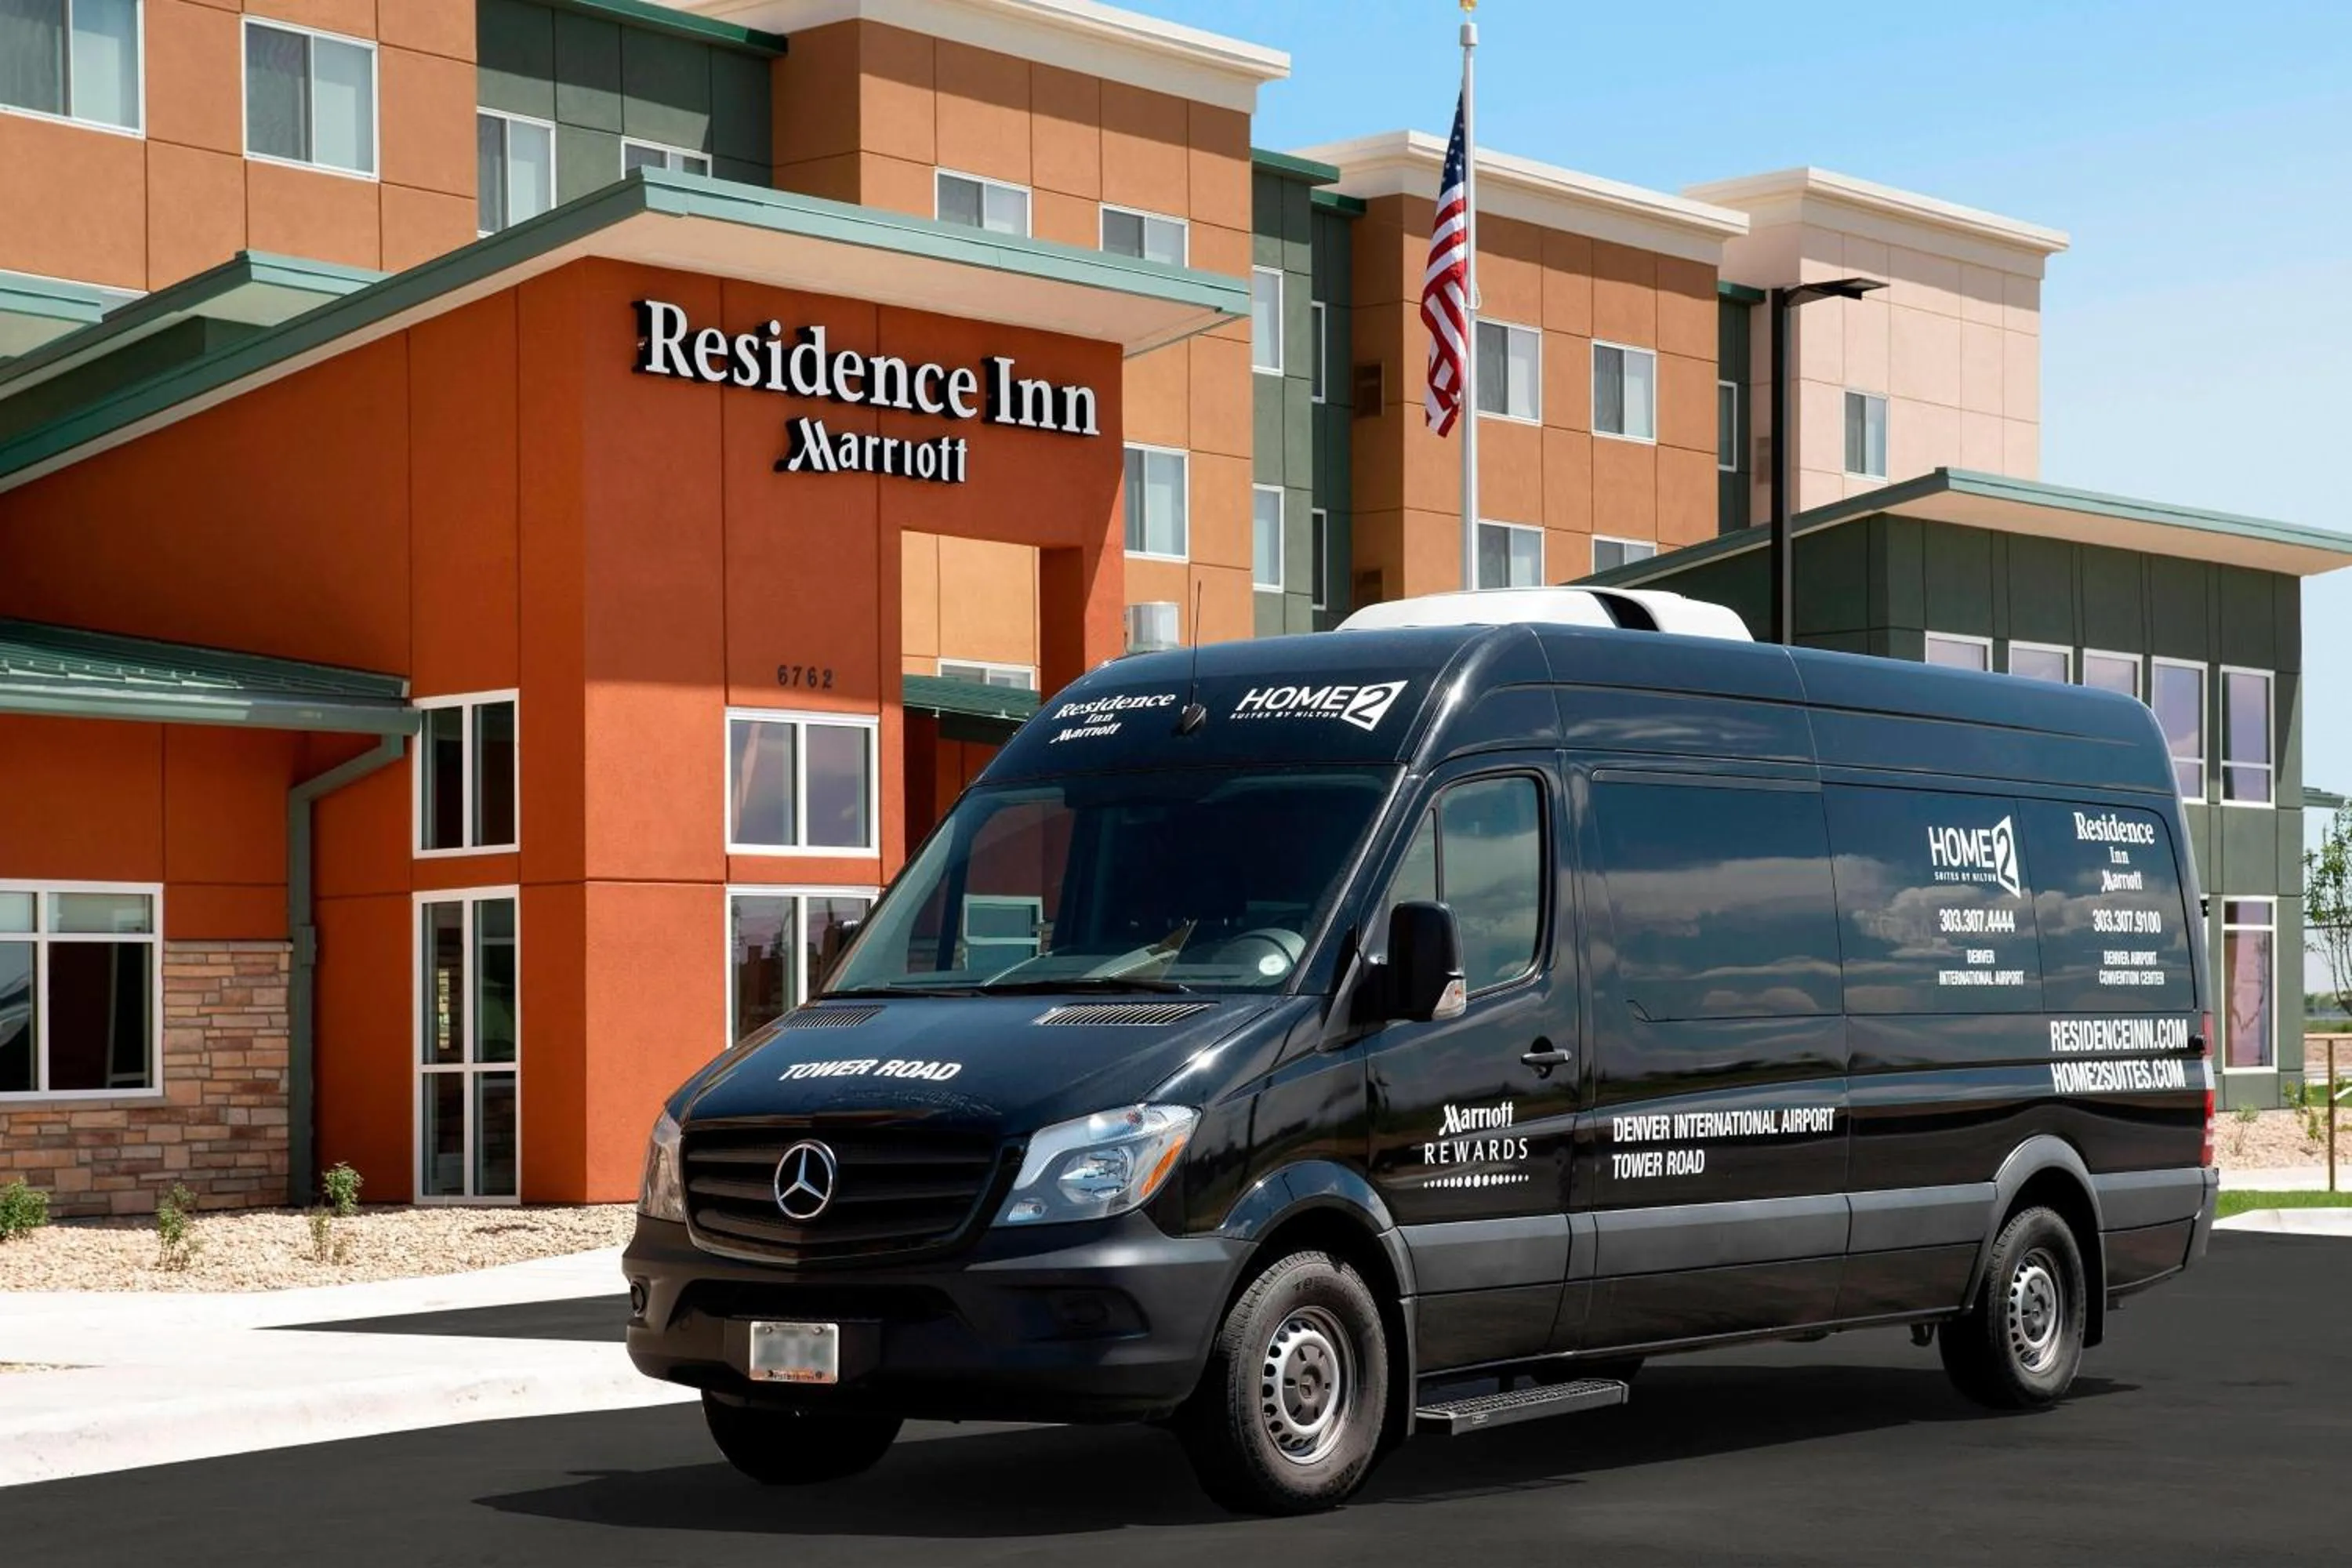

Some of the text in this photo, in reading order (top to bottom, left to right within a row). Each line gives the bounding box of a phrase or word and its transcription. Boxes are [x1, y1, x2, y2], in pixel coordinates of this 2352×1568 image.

[644, 299, 1101, 436] Residence Inn
[788, 417, 967, 482] Marriott
[778, 665, 833, 689] 6762
[1051, 694, 1176, 720] Residence
[1084, 713, 1114, 724] Inn
[1229, 710, 1271, 719] SUITES
[1049, 722, 1122, 744] Marriott
[2073, 811, 2155, 844] Residence
[2109, 846, 2129, 864] Inn
[1934, 871, 1959, 881] SUITES
[1973, 872, 1997, 882] HILTON
[2101, 869, 2143, 893] Marriott
[1939, 909, 2016, 932] 303.307.4444
[2092, 909, 2161, 933] 303.307.9100
[1966, 949, 1995, 964] DENVER
[2103, 950, 2157, 965] DENVER AIRPORT
[1939, 970, 2024, 985] INTERNATIONAL AIRPORT
[2099, 970, 2165, 985] CONVENTION CENTER
[2050, 1019, 2188, 1051] RESIDENCEINN.COM
[779, 1059, 962, 1081] TOWER ROAD
[2051, 1059, 2186, 1092] HOME2SUITES.COM
[1439, 1101, 1513, 1135] Marriott
[1613, 1108, 1835, 1142] DENVER INTERNATIONAL AIRPORT
[1424, 1138, 1528, 1164] REWARDS
[1612, 1149, 1705, 1180] TOWER ROAD
